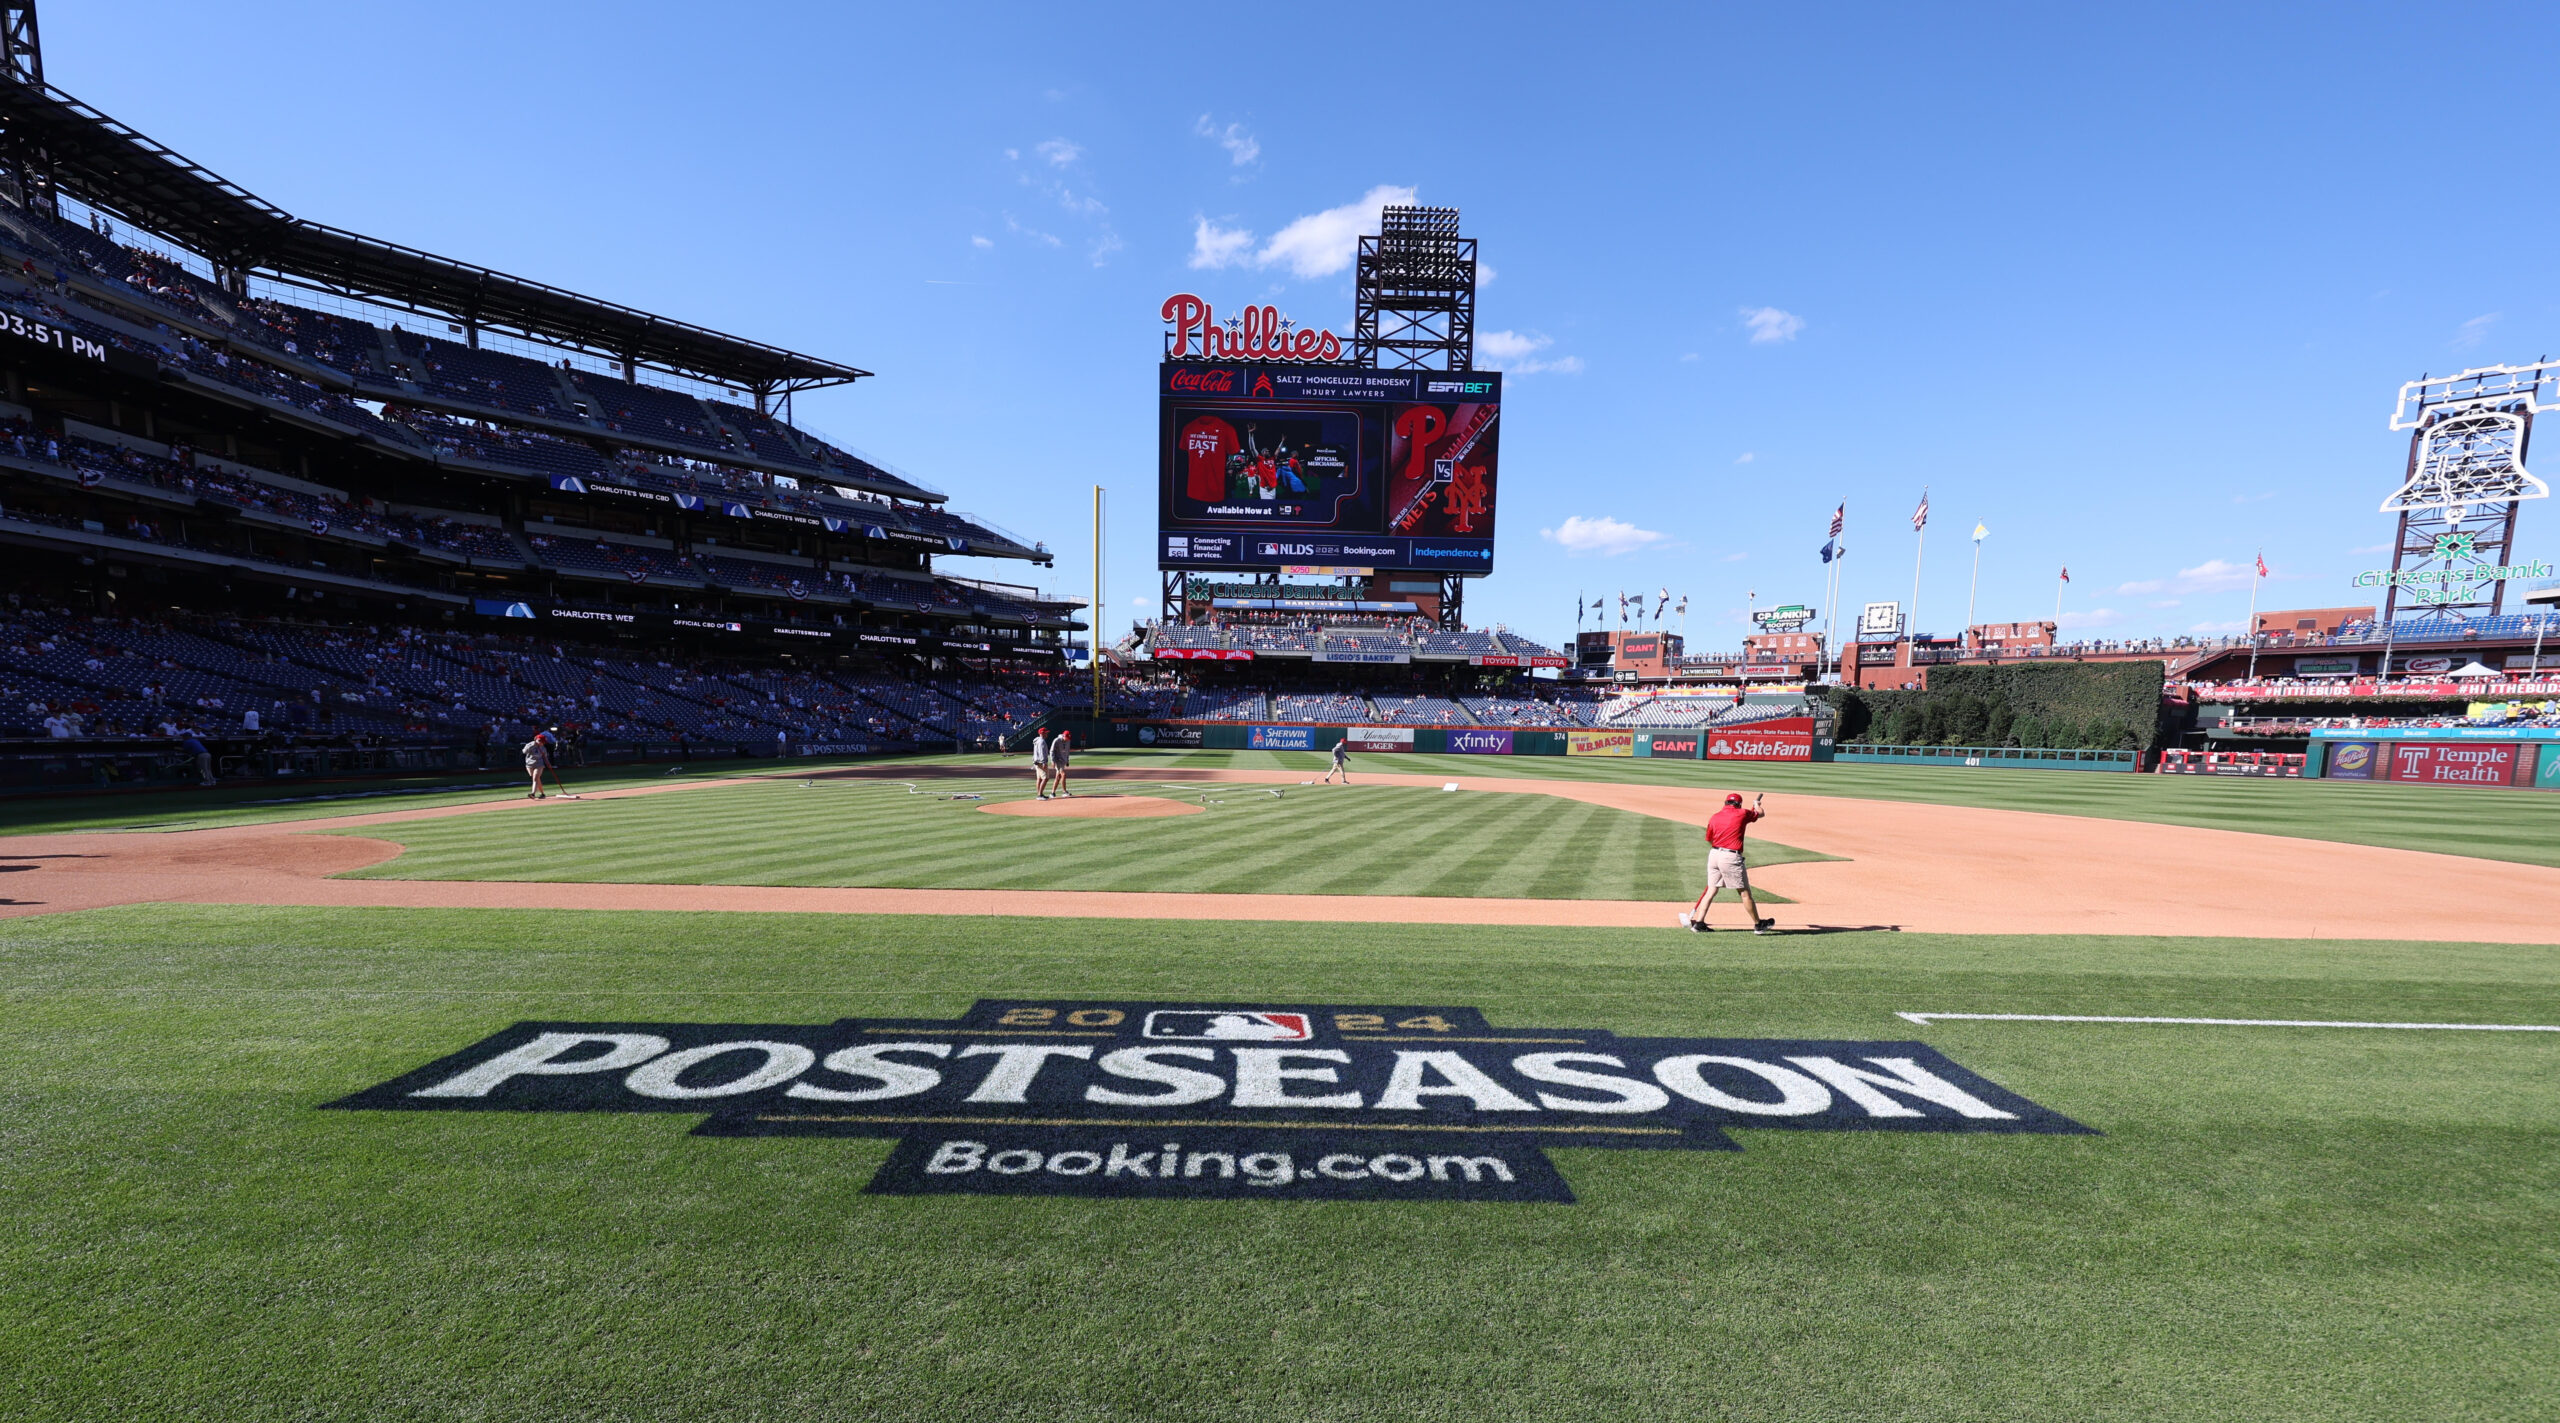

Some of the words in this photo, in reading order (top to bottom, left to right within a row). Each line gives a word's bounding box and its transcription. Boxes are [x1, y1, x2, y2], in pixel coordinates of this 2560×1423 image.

[1161, 292, 1342, 361] Phillies
[72, 336, 105, 362] PM
[1170, 368, 1236, 392] Coca-Cola
[1276, 375, 1302, 384] SALTZ
[1306, 376, 1362, 385] MONGELUZZI
[1366, 378, 1411, 386] BENDESKY
[1428, 381, 1464, 393] ESPN
[1464, 382, 1493, 394] BET
[1188, 440, 1218, 452] EAST
[590, 484, 637, 497] CHARLOTTE'S
[638, 492, 654, 500] WEB
[655, 494, 670, 502] CBD
[754, 510, 792, 522] CHARLOTTE'S
[1206, 506, 1244, 515] Available
[1244, 506, 1263, 515] Now
[1263, 507, 1272, 515] at
[1401, 491, 1437, 531] METS
[890, 532, 922, 542] CHARLOTTE'S
[1193, 538, 1231, 546] Connecting
[1280, 544, 1314, 556] NLDS
[1343, 546, 1396, 556] Booking.com
[1415, 548, 1479, 558] Independence
[2357, 567, 2467, 587] Citizens
[2474, 559, 2549, 581] Bank
[1213, 582, 1280, 599] Citizens
[1283, 584, 1326, 600] Bank
[1328, 586, 1365, 600] Park
[2414, 585, 2476, 604] Park
[552, 609, 613, 621] CHARLOTTE'S
[1772, 610, 1811, 620] RANKIN
[673, 619, 701, 627] OFFICIAL
[774, 628, 832, 637] CHARLOTTESWEB.COM
[860, 634, 901, 644] CHARLOTTE'S
[1158, 650, 1168, 658] JIM
[1168, 648, 1184, 658] BEAM
[1191, 650, 1202, 659] JIM
[1202, 649, 1217, 660] BEAM
[1625, 644, 1656, 653] GIANT
[1224, 651, 1236, 660] JIM
[1236, 650, 1250, 660] BEAM
[1484, 657, 1517, 665] TOYOTA
[1533, 658, 1565, 666] TOYOTA
[2198, 686, 2255, 697] Budweiser
[2264, 686, 2350, 696] #HITTHEBUDS
[2370, 684, 2439, 696] Budweiser
[1156, 728, 1202, 740] NovaCare
[1266, 728, 1307, 738] SHERWIN
[1360, 729, 1400, 742] Yuengling
[1637, 734, 1650, 742] 387
[1264, 738, 1308, 748] WILLIAMS.
[1454, 732, 1506, 752] xfinity
[1652, 740, 1696, 752] GIANT
[1820, 738, 1833, 746] 409
[812, 744, 867, 754] POSTSEASON
[1964, 757, 1980, 766] 401
[2335, 748, 2370, 766] Hatfield
[2436, 748, 2508, 764] Temple
[2433, 766, 2500, 782] Health
[997, 1007, 1125, 1027] 20
[1333, 1014, 1456, 1032] 24
[406, 1031, 2019, 1121] POSTSEASON
[925, 1141, 1515, 1186] Booking.com
